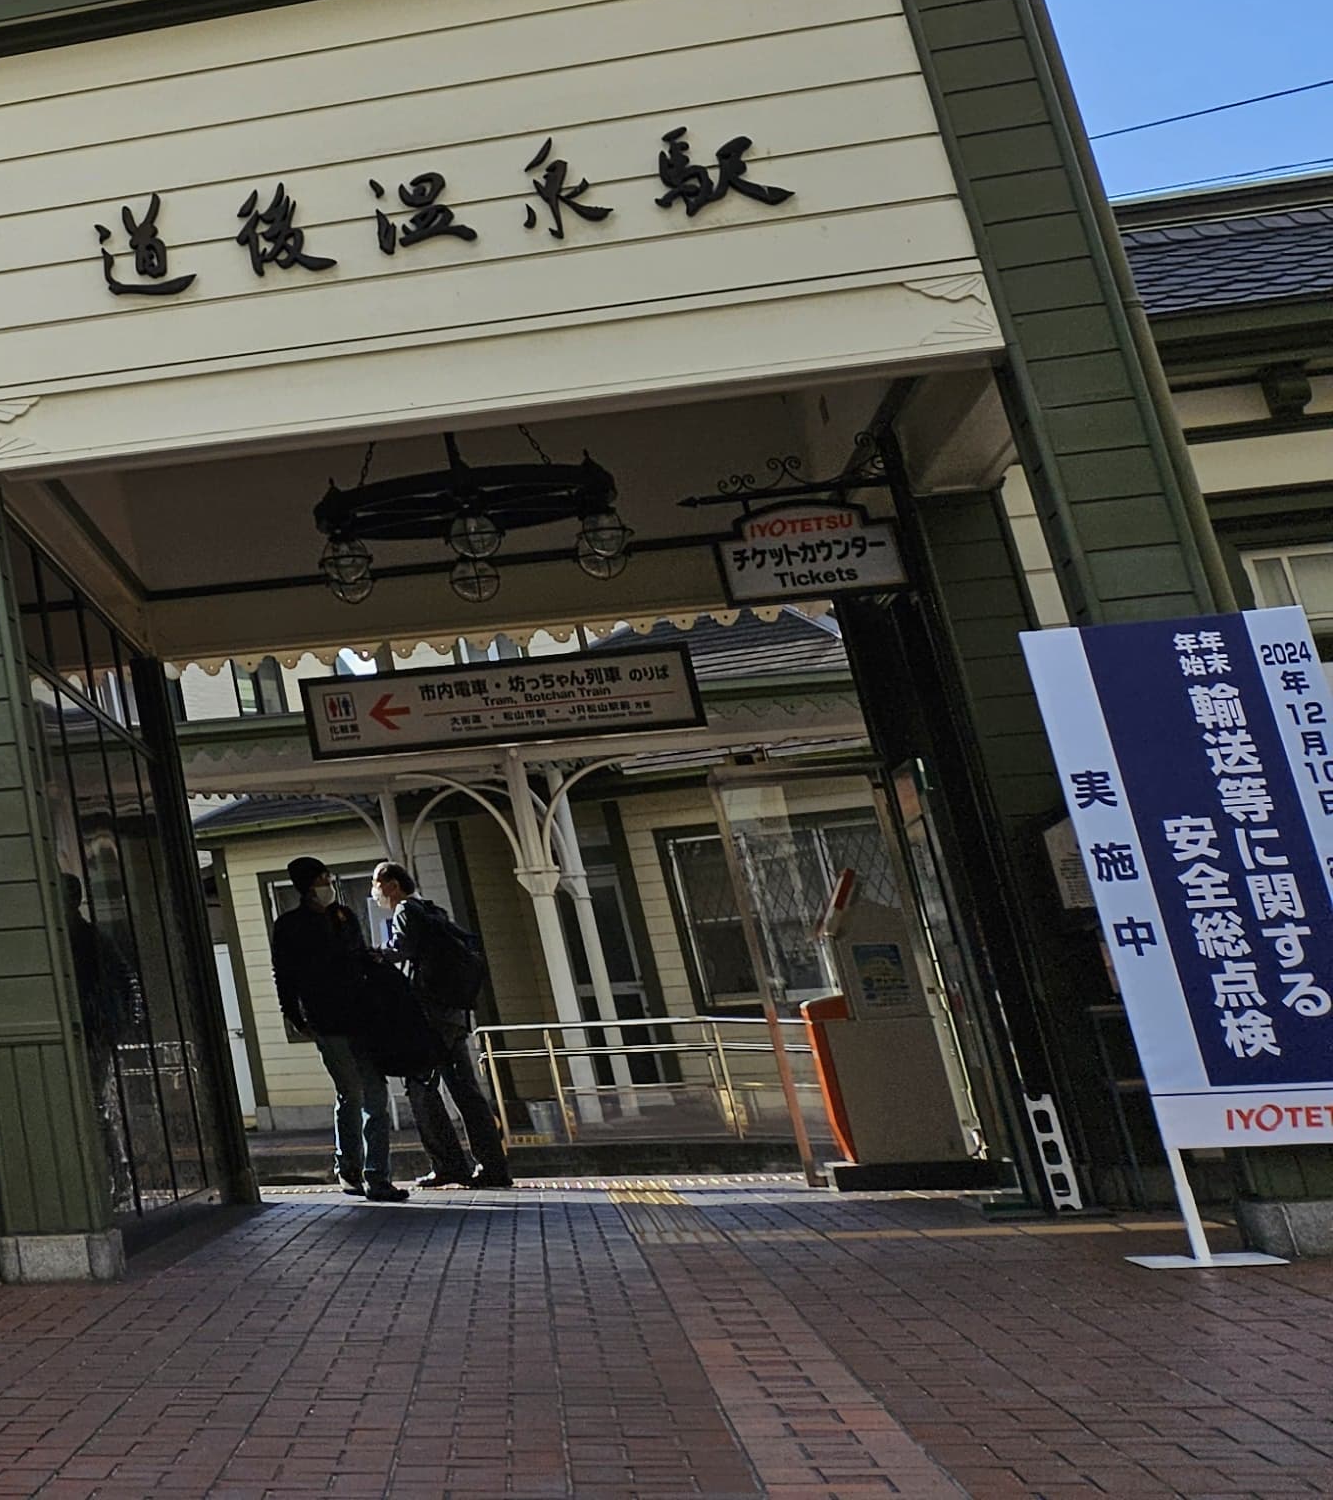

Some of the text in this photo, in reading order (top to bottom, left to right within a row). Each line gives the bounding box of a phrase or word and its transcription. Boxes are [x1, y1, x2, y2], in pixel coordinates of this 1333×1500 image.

[95, 126, 795, 295] 道後温泉駅
[750, 513, 854, 538] IYOTETSU
[733, 536, 886, 571] チケットカウンター
[774, 567, 859, 588] Tickets
[419, 664, 670, 702] 市内電車・坊っちゃん列車 のりば
[524, 689, 575, 703] Botchan
[576, 686, 612, 698] Train
[1070, 769, 1159, 958] 実施中
[1187, 682, 1332, 1017] 輸送等に関する
[1163, 815, 1281, 1058] 安全総点検
